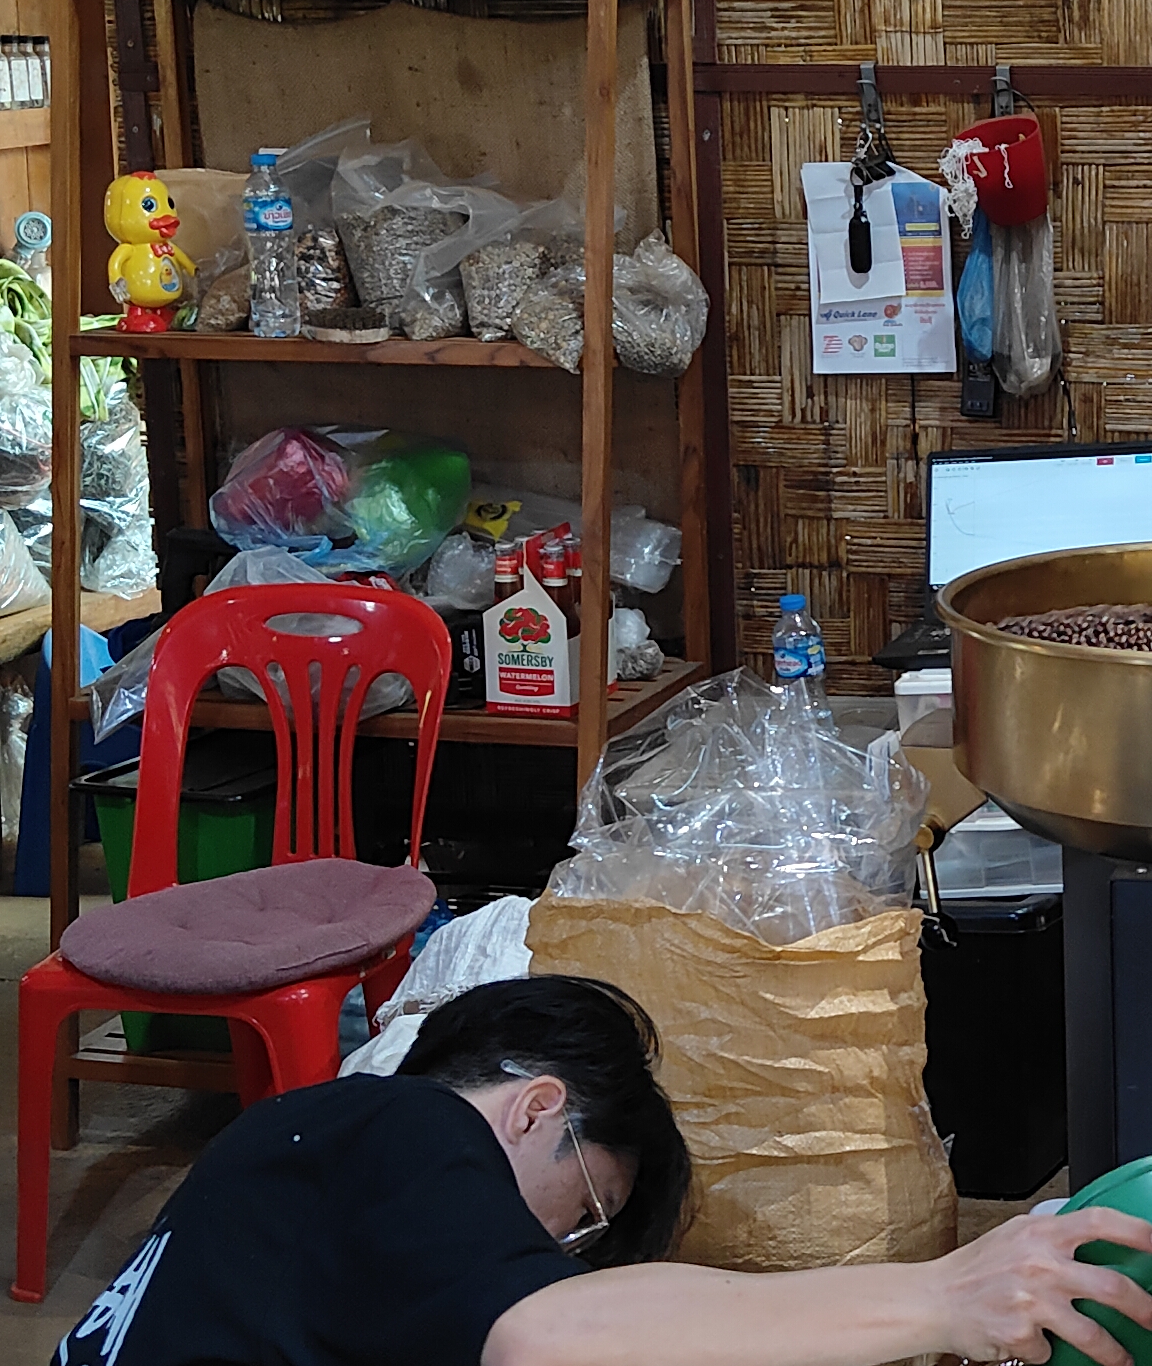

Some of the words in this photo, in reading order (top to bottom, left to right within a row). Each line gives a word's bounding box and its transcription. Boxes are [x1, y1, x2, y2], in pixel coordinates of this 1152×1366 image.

[833, 310, 856, 319] Quick
[857, 309, 878, 318] Lane
[497, 652, 554, 668] SOMERSBY
[500, 671, 554, 682] WATERMELON
